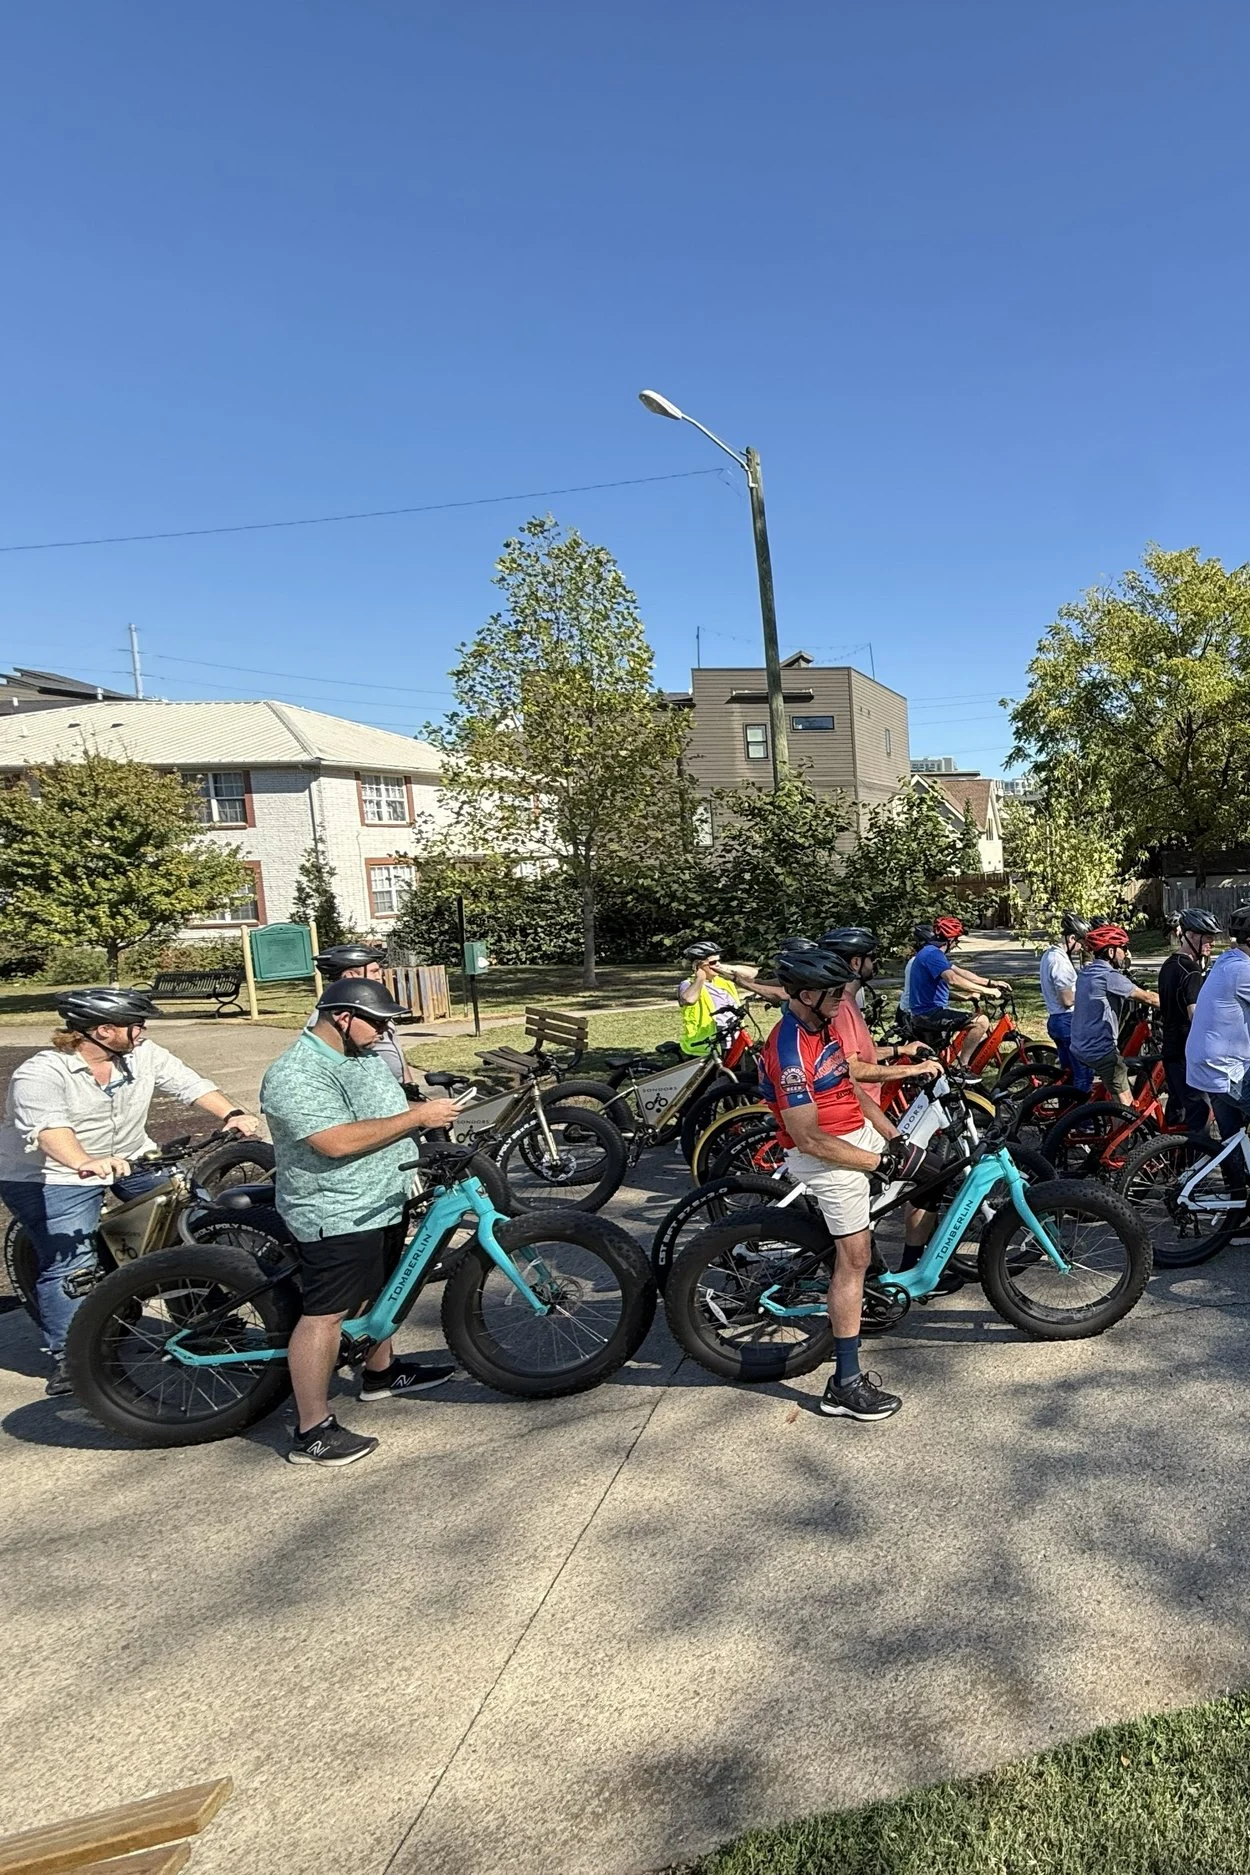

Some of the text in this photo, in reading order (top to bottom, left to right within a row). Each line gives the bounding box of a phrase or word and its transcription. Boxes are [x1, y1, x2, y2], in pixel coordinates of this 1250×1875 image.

[901, 1103, 924, 1134] NDORS
[730, 1141, 747, 1154] CST
[935, 1200, 974, 1260] TOMBERLIN
[387, 1233, 432, 1302] TOMBERLIN
[658, 1245, 668, 1266] CST
